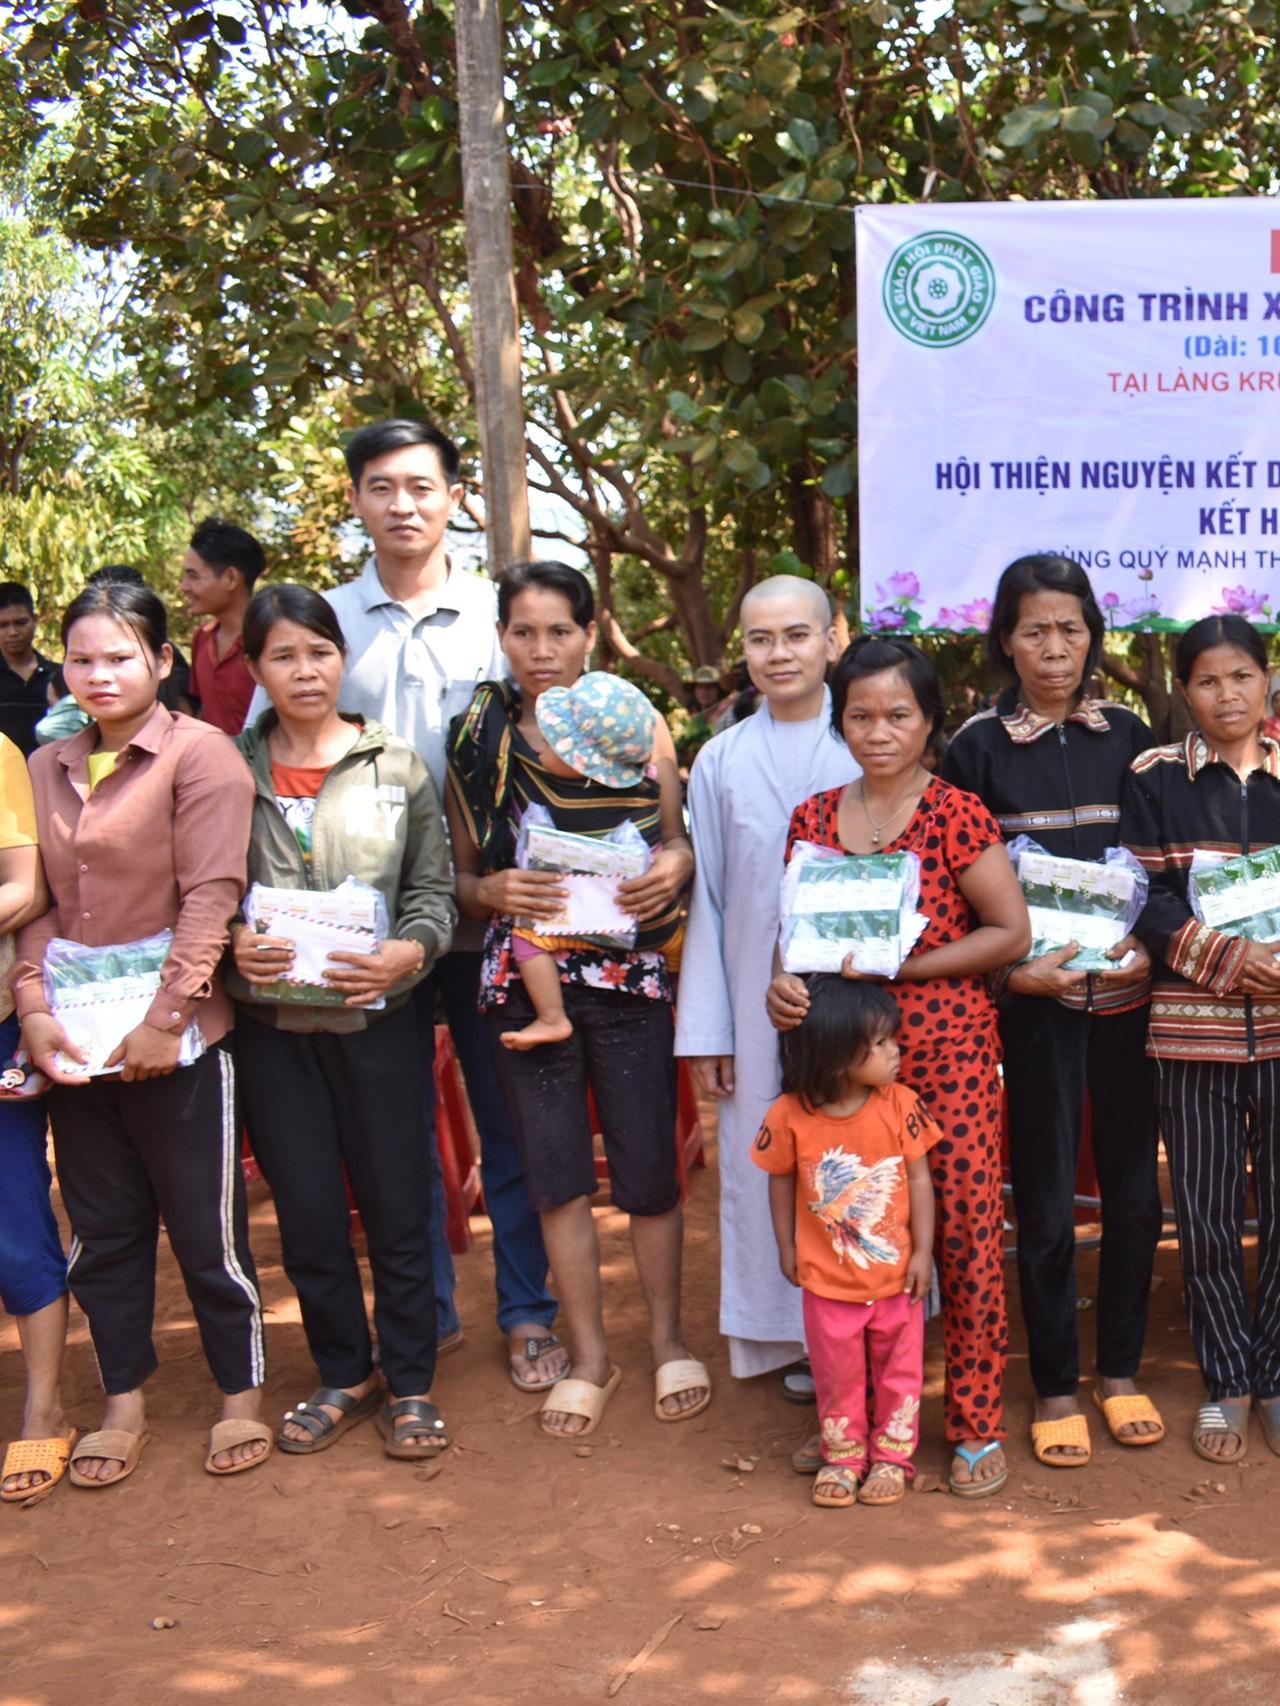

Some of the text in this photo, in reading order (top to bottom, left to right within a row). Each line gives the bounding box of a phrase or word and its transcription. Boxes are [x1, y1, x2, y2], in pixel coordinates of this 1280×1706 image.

[1024, 288, 1124, 323] CÔNG
[1137, 286, 1248, 321] TRÌNH
[1184, 335, 1246, 359] (Dài:
[1108, 371, 1147, 397] TẠI
[1158, 367, 1229, 392] LÀNG
[936, 456, 980, 496] HỘI
[990, 455, 1071, 496] THIỆN
[1081, 454, 1195, 495] NGUYỆN
[1206, 451, 1258, 489] KẾT
[1199, 498, 1251, 535] KẾT
[1119, 545, 1168, 569] QUÝ
[1177, 550, 1246, 574] MẠNH
